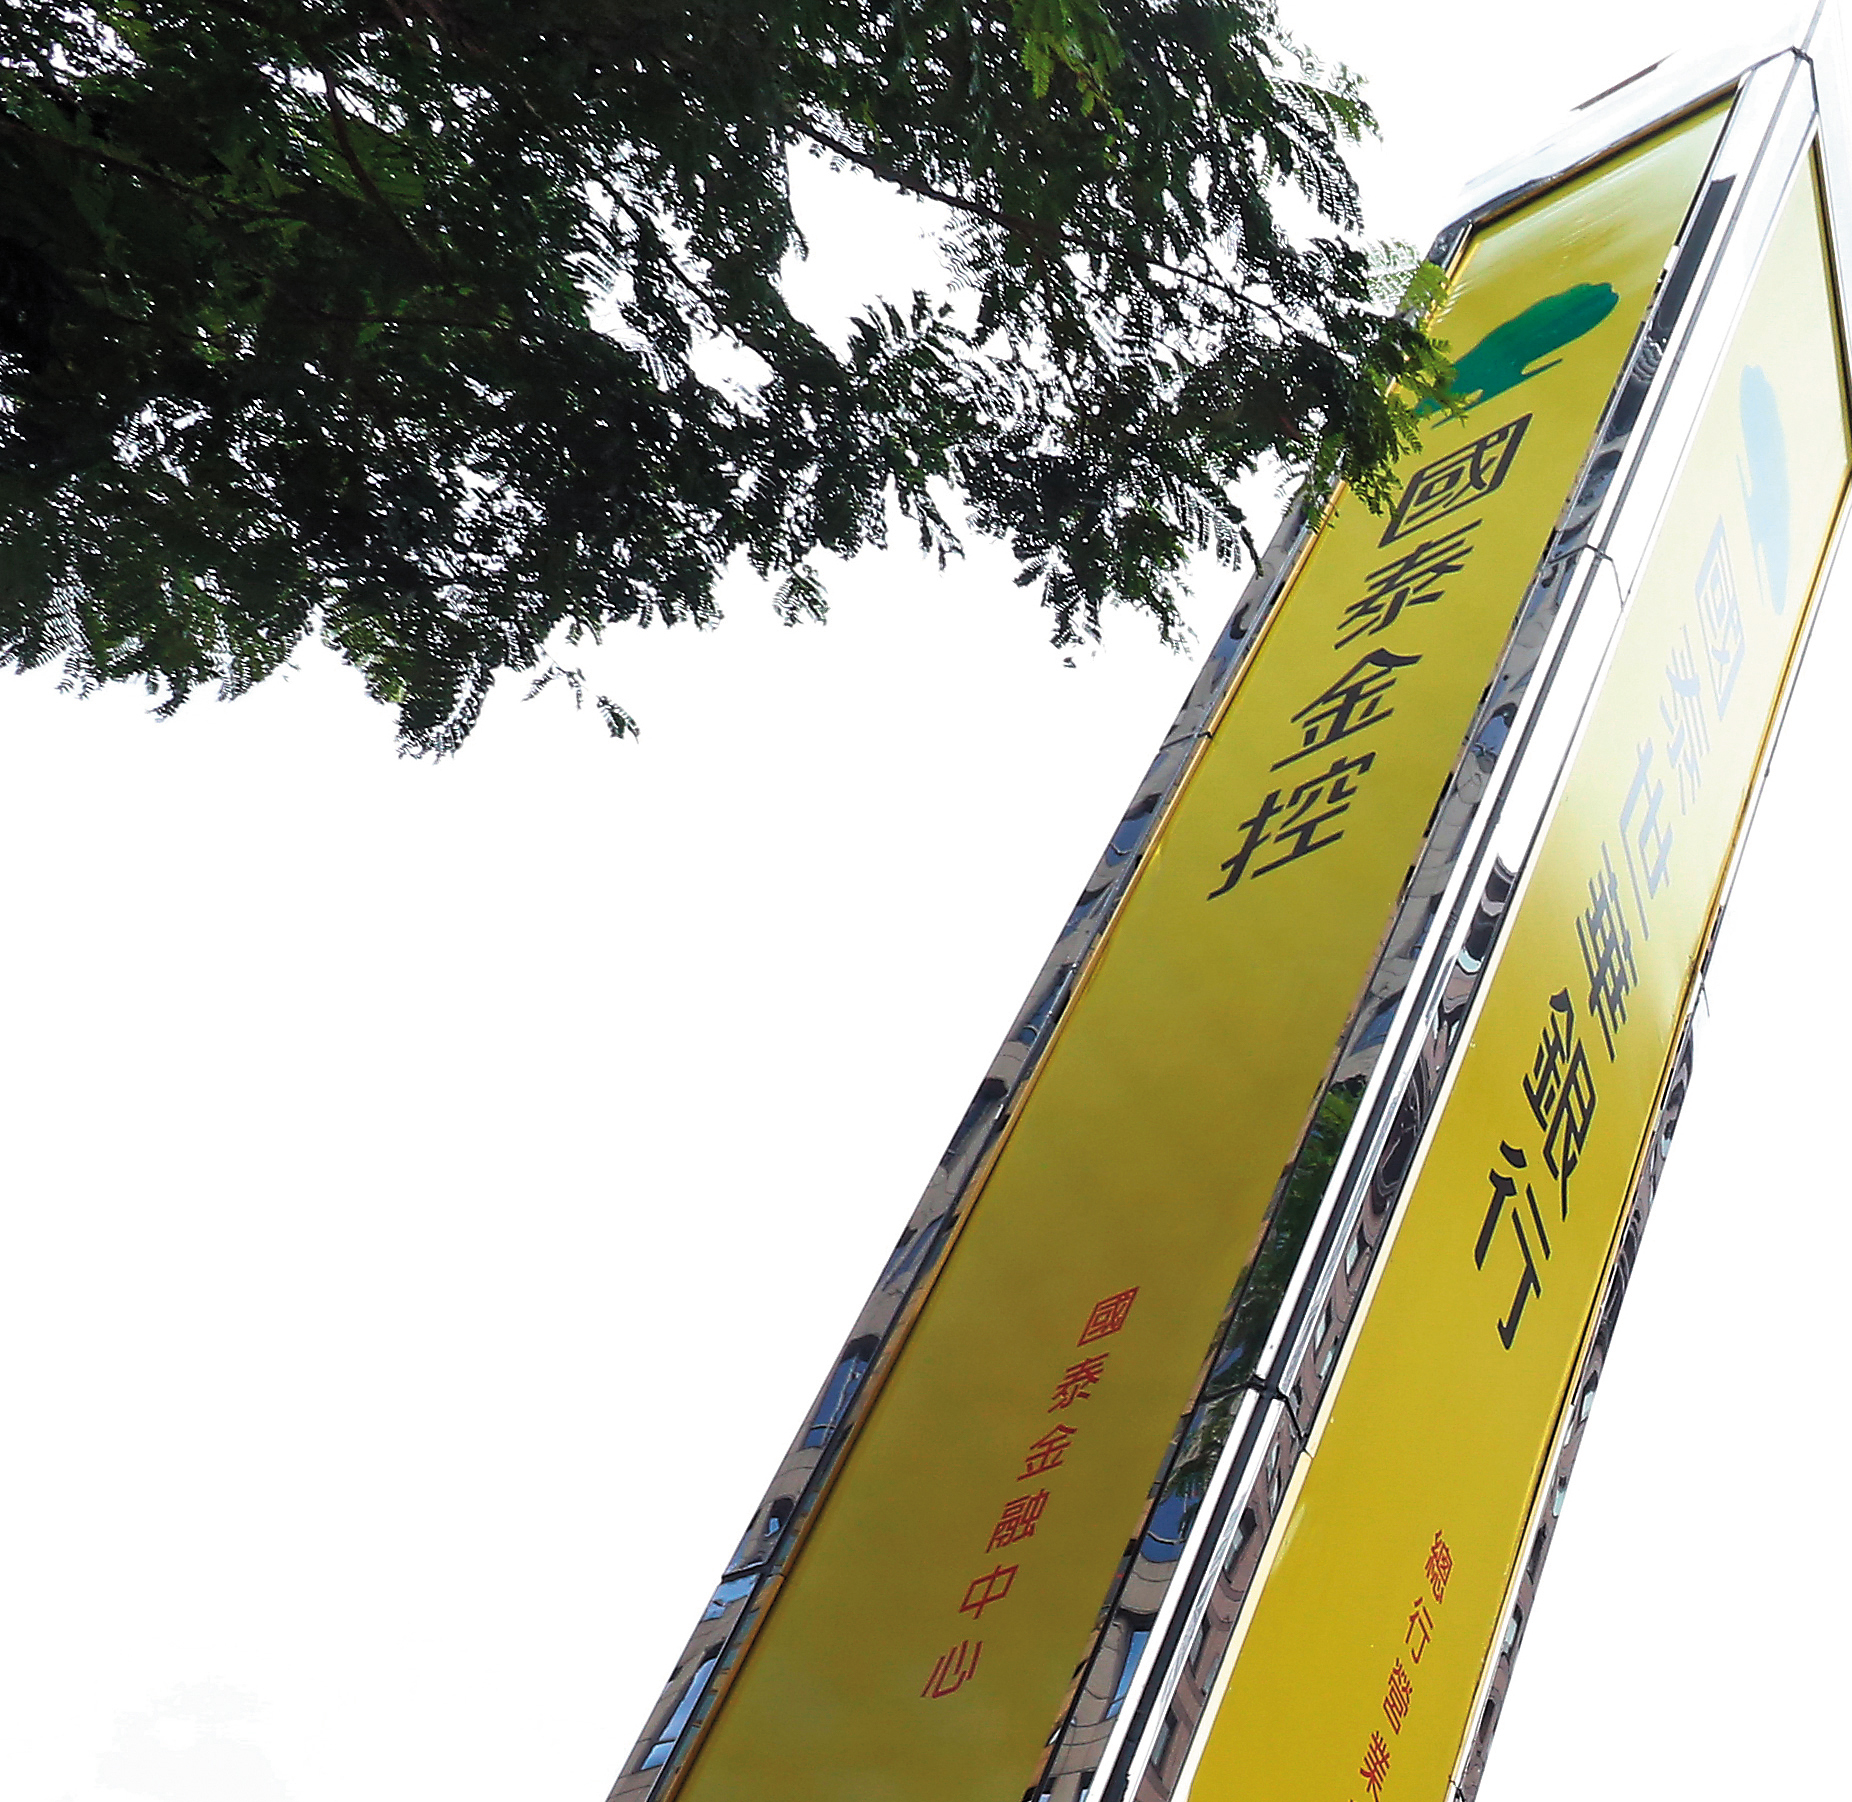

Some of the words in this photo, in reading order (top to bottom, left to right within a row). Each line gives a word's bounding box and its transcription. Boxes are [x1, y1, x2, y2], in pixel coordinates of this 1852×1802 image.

[1207, 413, 1532, 901] 國泰金控
[1474, 514, 1746, 1351] 國泰世華銀行
[920, 1286, 1140, 1699] 國泰金融中心
